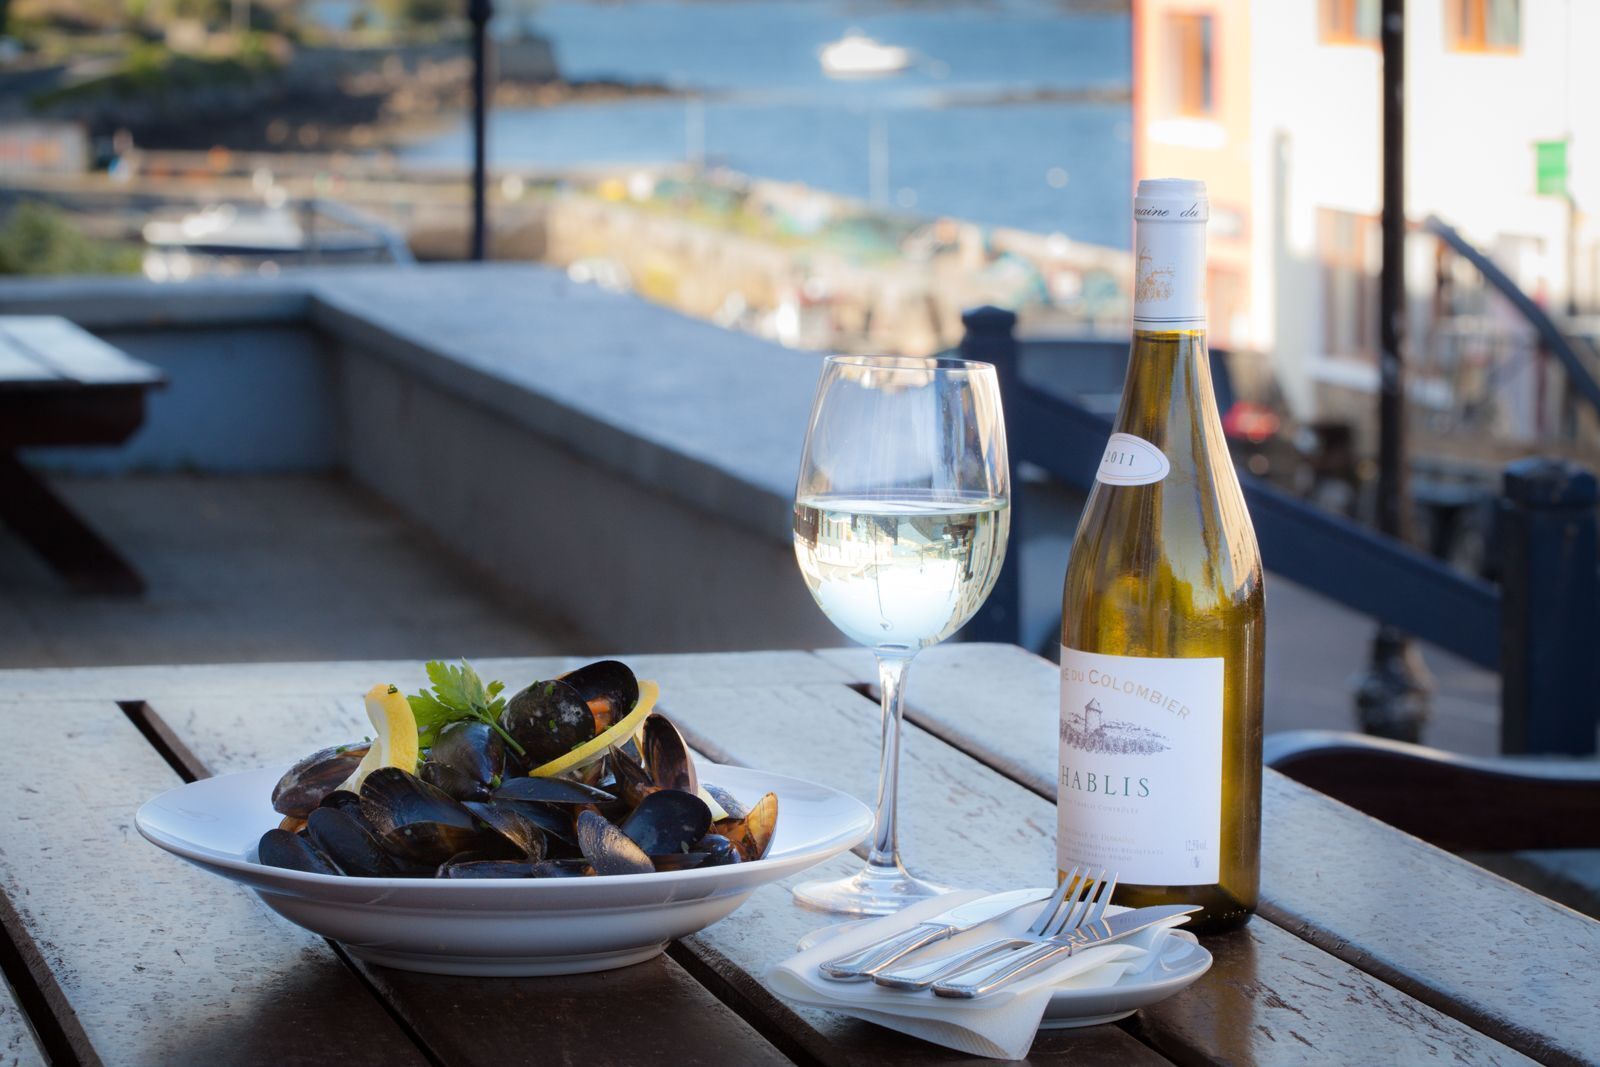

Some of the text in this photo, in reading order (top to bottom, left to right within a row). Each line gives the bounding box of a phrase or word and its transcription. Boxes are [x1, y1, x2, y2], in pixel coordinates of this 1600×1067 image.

[1180, 202, 1199, 217] du
[1072, 669, 1084, 682] DU
[1088, 669, 1191, 720] COLOMBIER
